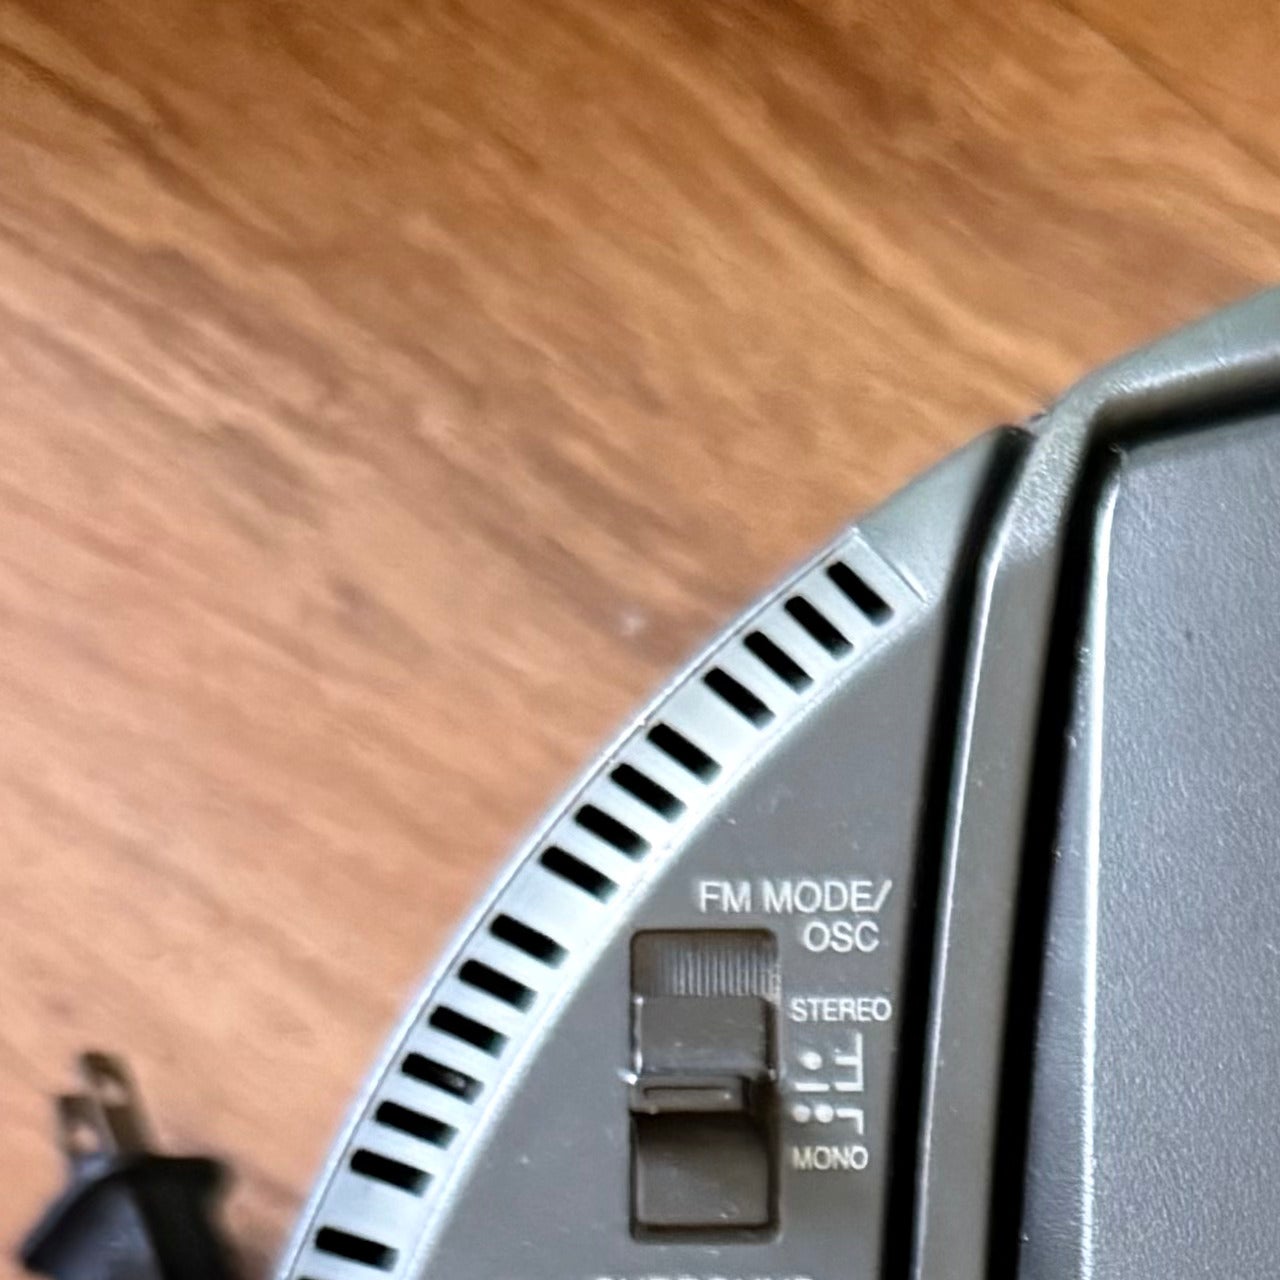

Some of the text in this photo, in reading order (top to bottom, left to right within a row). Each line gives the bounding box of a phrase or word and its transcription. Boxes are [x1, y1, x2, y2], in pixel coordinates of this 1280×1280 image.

[698, 879, 892, 914] FM MODE/
[803, 922, 880, 953] OSC
[789, 999, 892, 1023] STEREO
[791, 1147, 869, 1170] MONO
